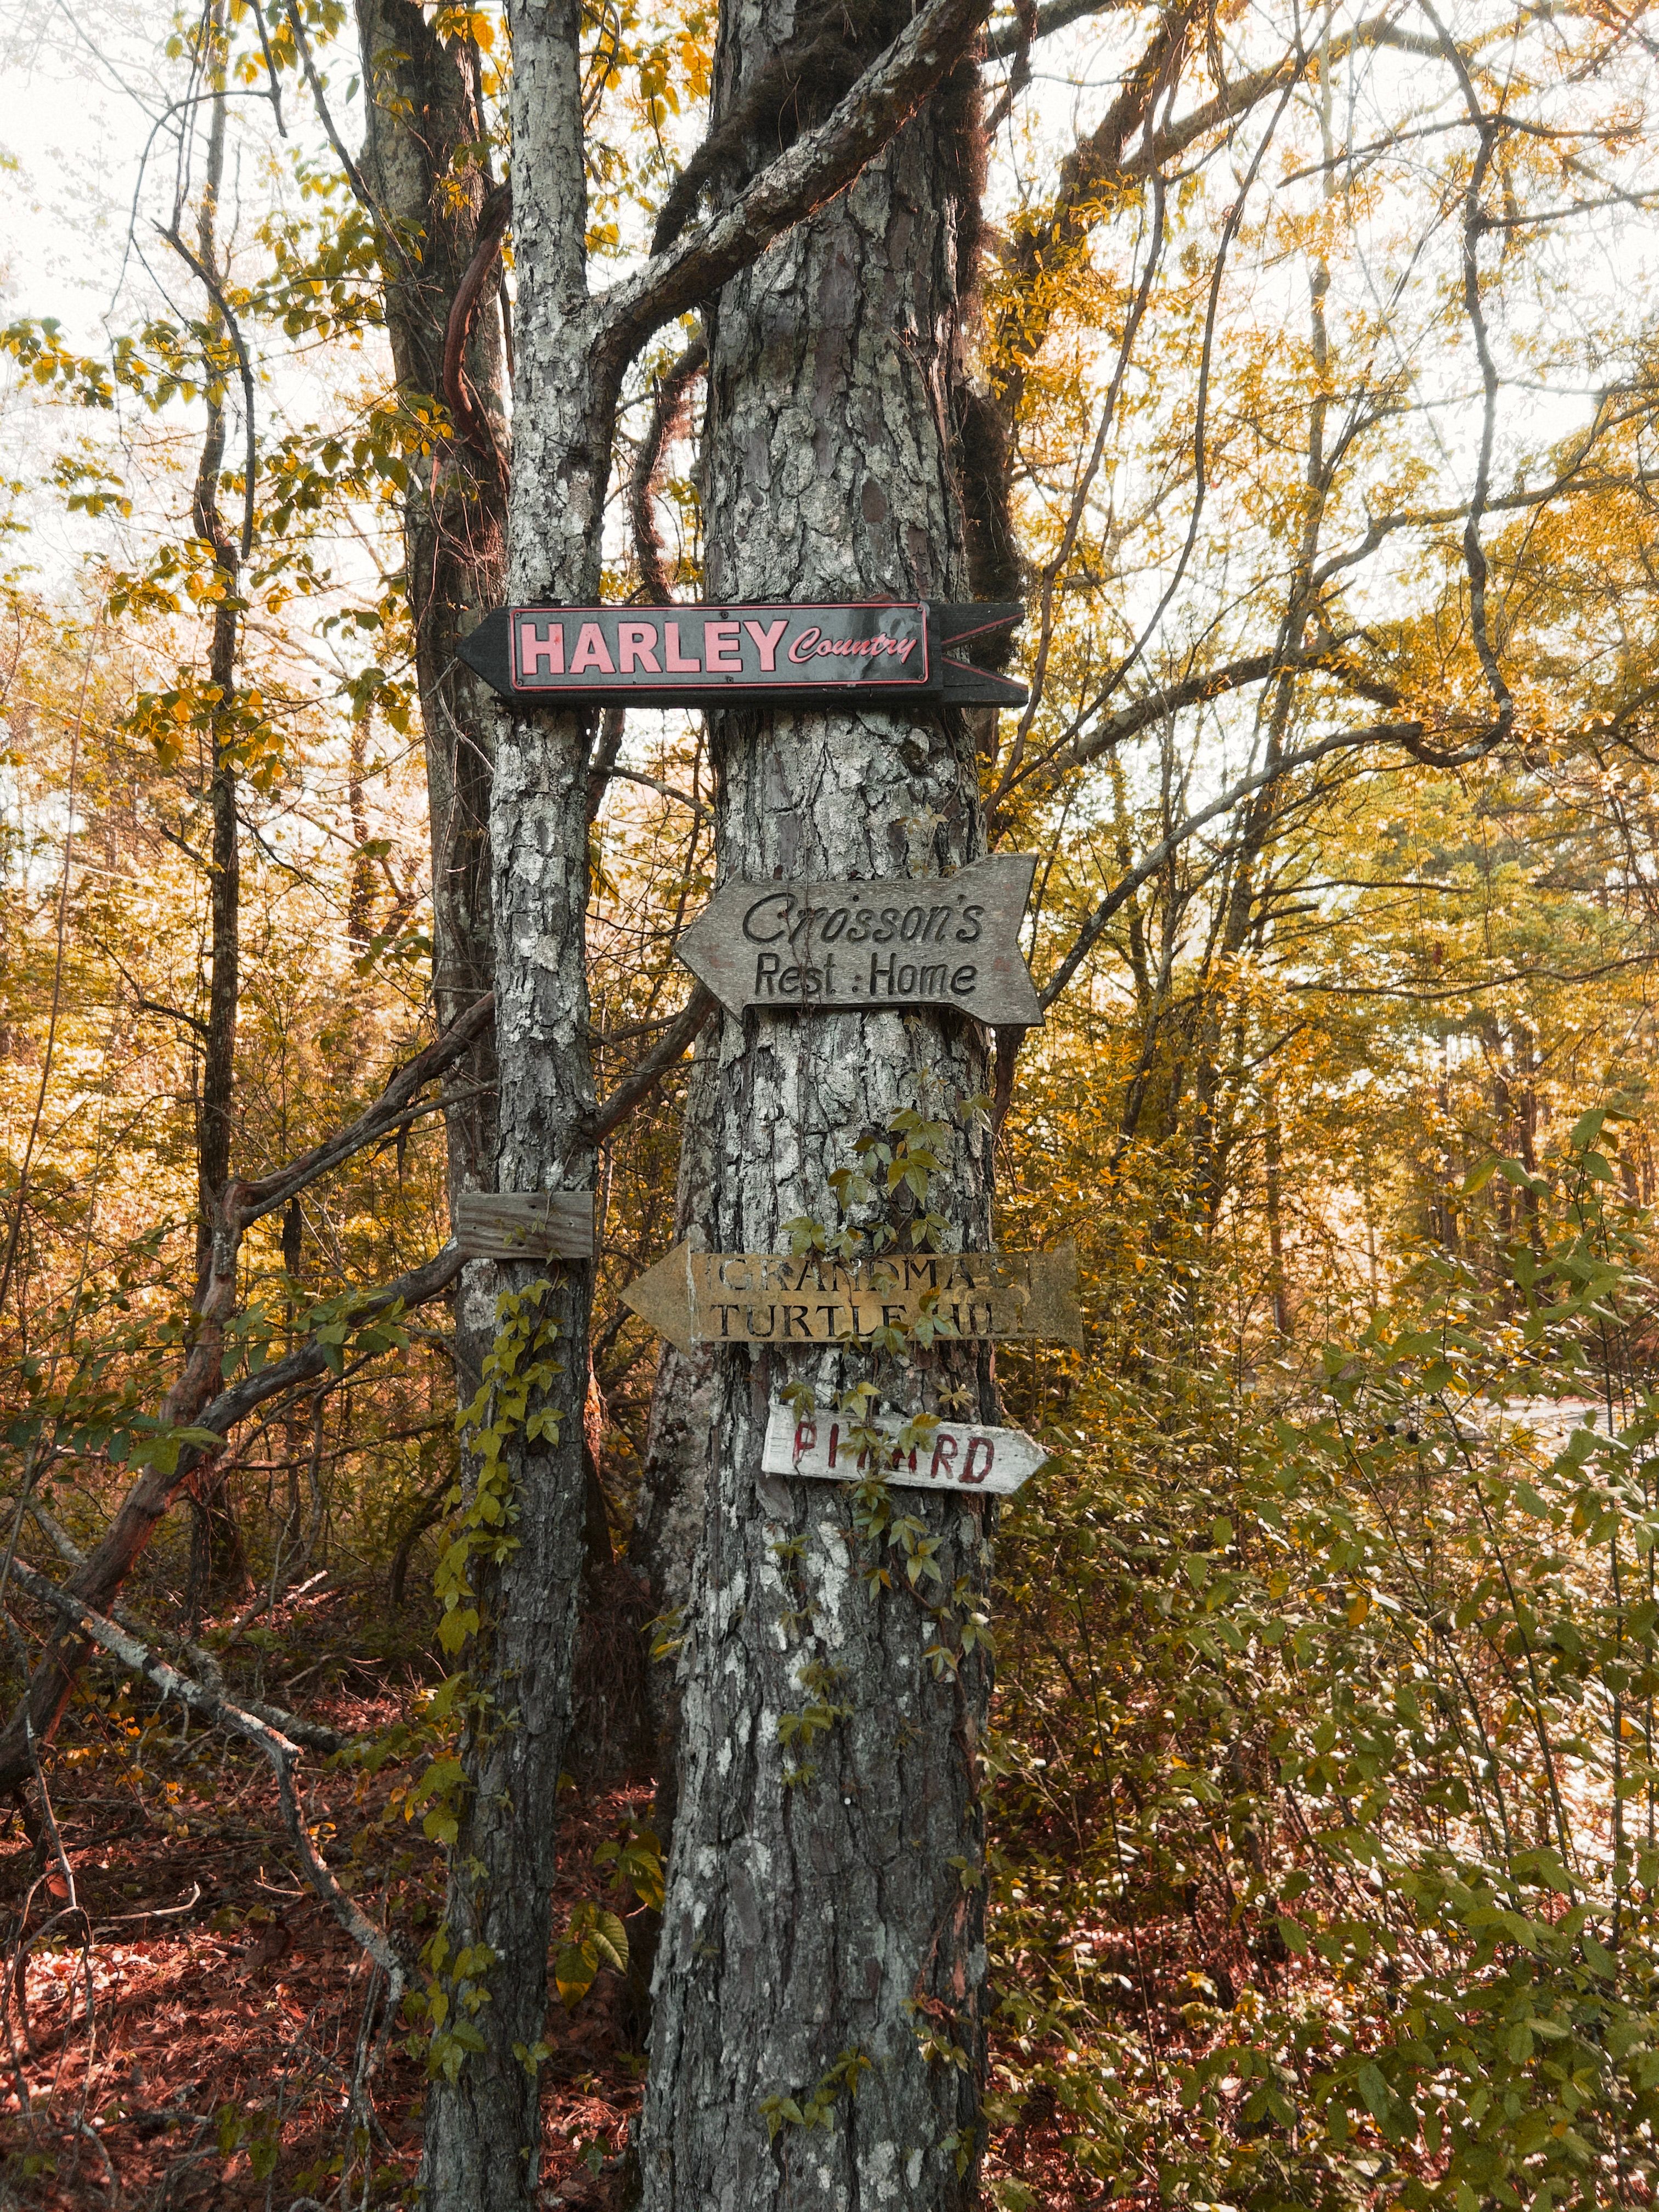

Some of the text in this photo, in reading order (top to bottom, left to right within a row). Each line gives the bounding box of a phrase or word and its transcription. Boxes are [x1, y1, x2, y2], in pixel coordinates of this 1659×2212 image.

[520, 620, 917, 675] HARLEY Country
[742, 892, 985, 944] Crosson's
[755, 952, 978, 996] Rest Home
[709, 1304, 907, 1337] TURTLE
